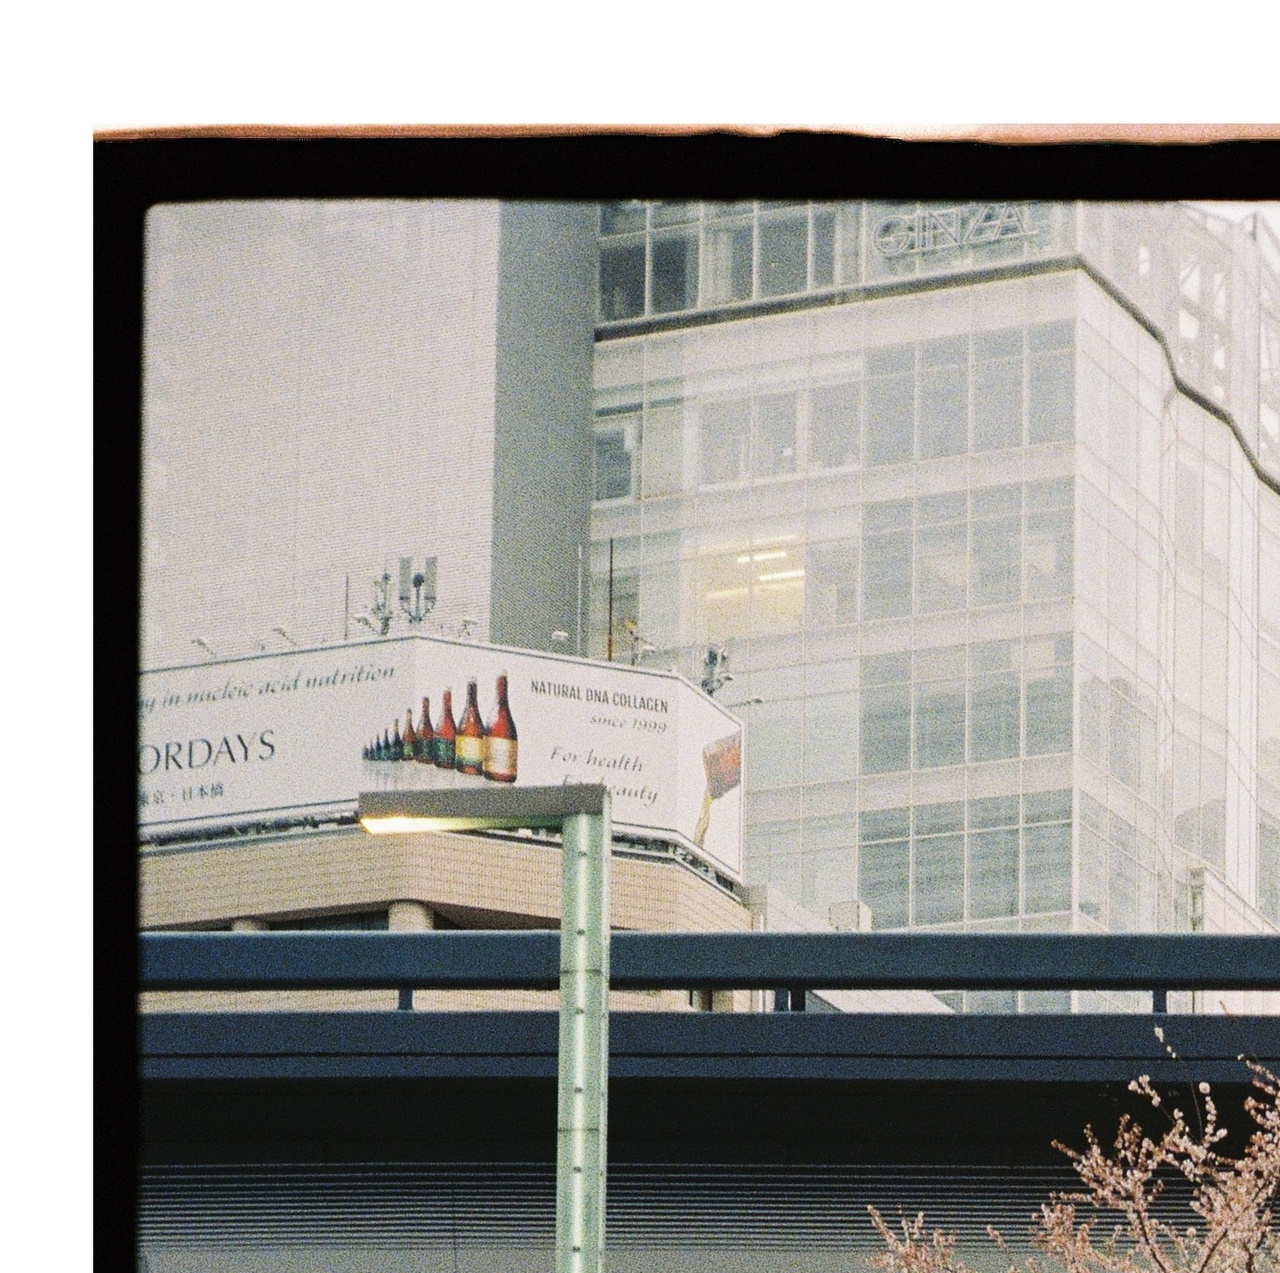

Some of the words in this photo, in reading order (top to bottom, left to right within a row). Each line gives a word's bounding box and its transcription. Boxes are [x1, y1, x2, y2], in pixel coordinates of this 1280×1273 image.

[306, 664, 394, 688] nutrition
[531, 680, 582, 700] NATURAL
[585, 688, 609, 705] DNA
[612, 692, 669, 714] COLLAGEN
[590, 714, 626, 729] since
[632, 718, 667, 734] 1999
[551, 746, 582, 763] For
[586, 748, 643, 773] health
[603, 778, 659, 807] eauty
